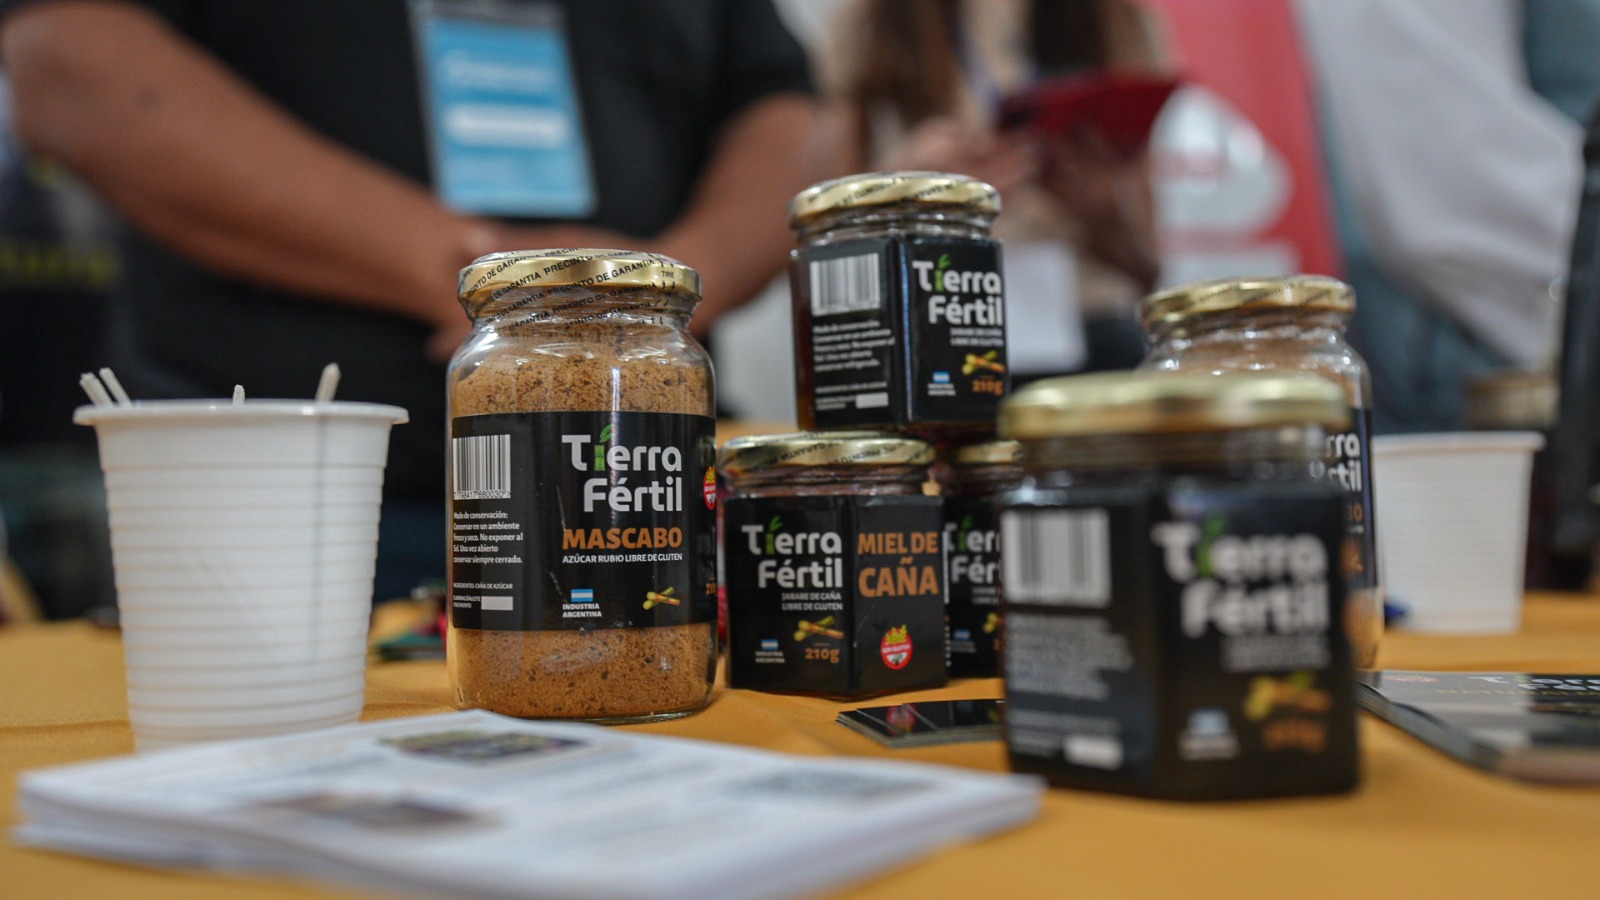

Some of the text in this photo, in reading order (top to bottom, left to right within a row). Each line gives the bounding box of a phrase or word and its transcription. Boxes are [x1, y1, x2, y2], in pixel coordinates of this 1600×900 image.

[487, 270, 496, 280] DE
[502, 272, 542, 296] GARANTIA
[544, 255, 592, 275] PRECINTO
[547, 277, 594, 296] PRECINTO
[596, 273, 610, 282] DE
[611, 260, 656, 279] GARANTIA
[661, 270, 674, 278] TIRE
[912, 254, 1002, 294] Tierra
[552, 297, 594, 314] PRECINTO
[595, 292, 606, 300] DE
[928, 295, 1003, 326] Fértil
[562, 425, 682, 472] Tierra
[583, 476, 683, 512] Fértil
[470, 510, 508, 519] conservación:
[488, 522, 520, 530] ambiente
[489, 534, 516, 542] exponer
[516, 532, 524, 540] al
[742, 516, 842, 555] Tierra
[478, 544, 499, 552] abierto
[562, 526, 683, 550] MASCABO
[858, 532, 940, 555] MIEL DE
[472, 555, 494, 565] siempre
[495, 554, 522, 564] cerrado.
[562, 553, 682, 564] AZÚCAR RUBIO LIBRE DE GLUTEN
[950, 555, 1001, 584] Fér
[758, 557, 843, 588] Fértil
[858, 556, 940, 598] CAÑA
[493, 581, 514, 590] AZÚCAR
[782, 591, 842, 600] JARABE DE CAÑA
[782, 602, 843, 610] LIBRE DE GLUTEN
[804, 648, 840, 664] 210g
